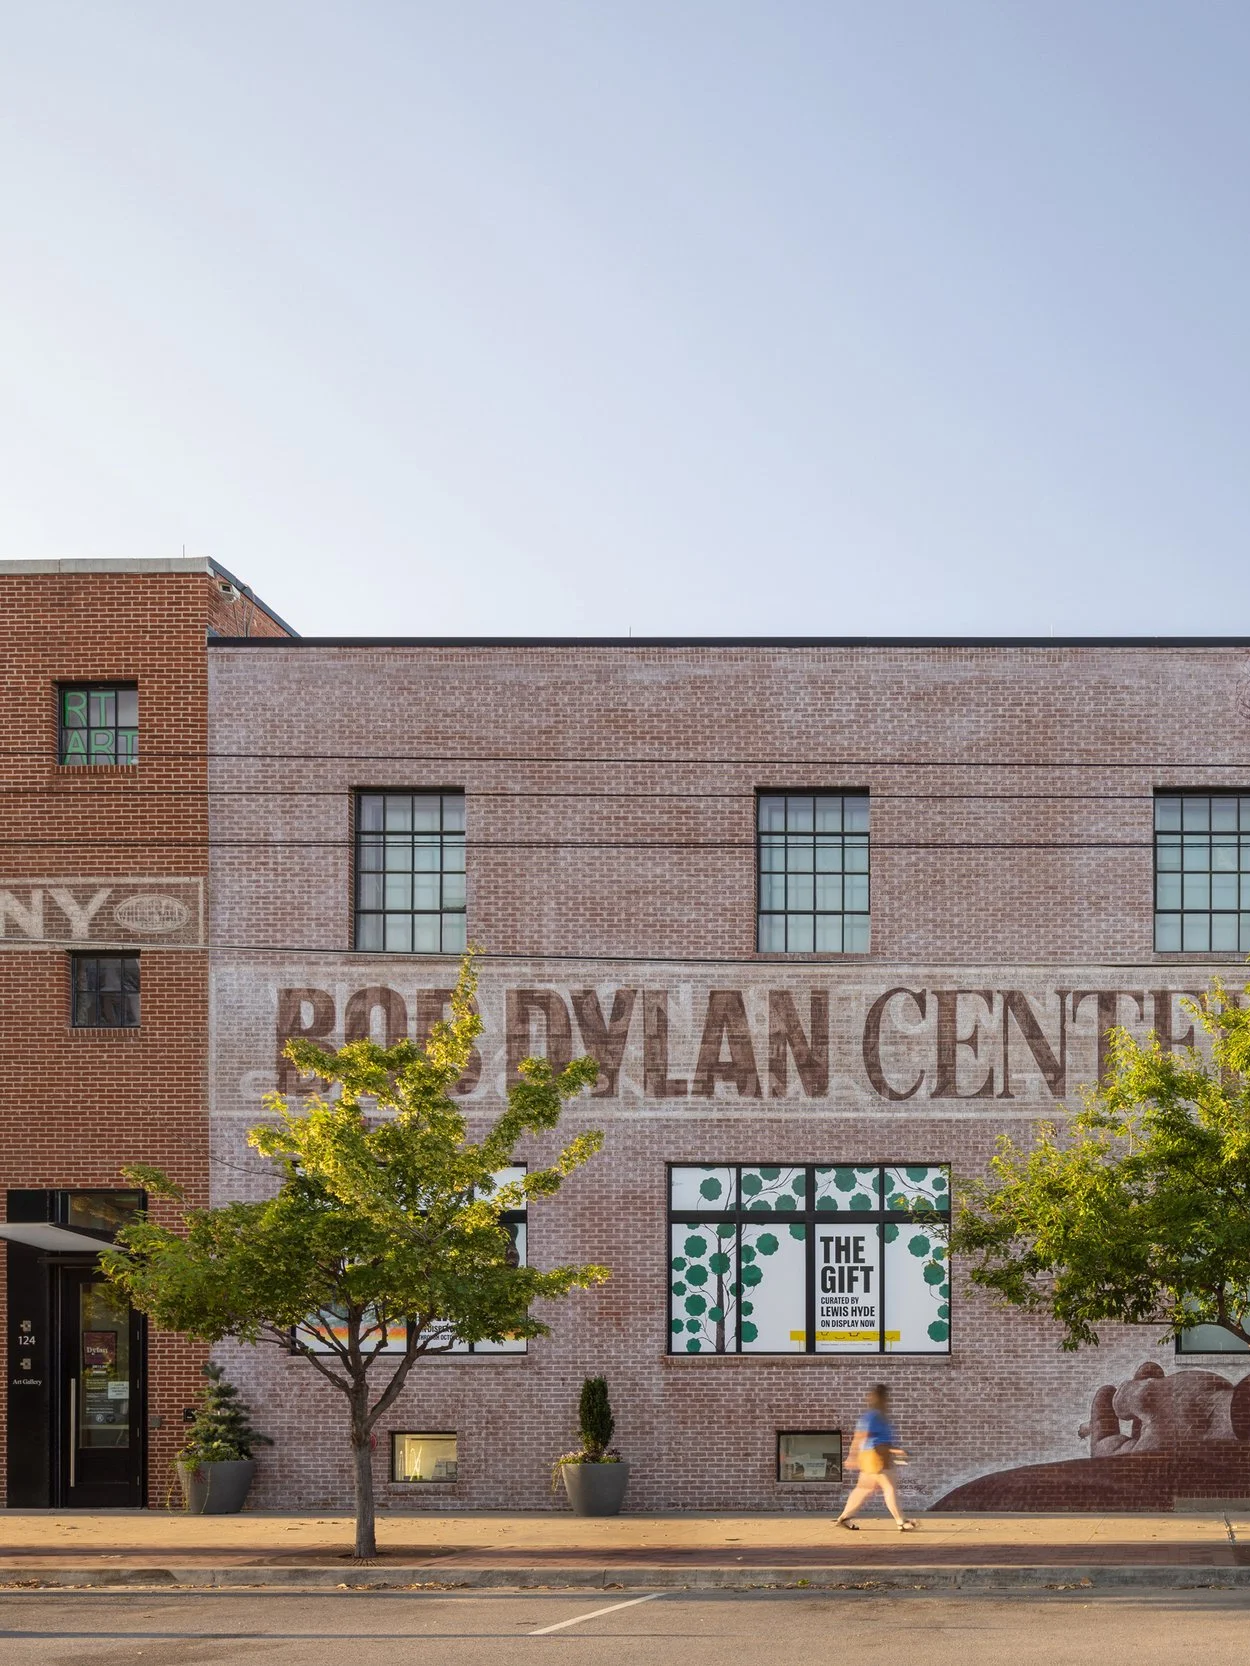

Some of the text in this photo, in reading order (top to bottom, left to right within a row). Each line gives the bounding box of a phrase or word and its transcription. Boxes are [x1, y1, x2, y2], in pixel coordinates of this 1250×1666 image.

[0, 888, 113, 939] NY
[505, 987, 829, 1099] DYLAN
[820, 1236, 865, 1263] THE
[821, 1266, 874, 1293] GIFT
[821, 1297, 859, 1305] CURATED BY
[821, 1306, 875, 1317] LEWIS HYDE
[821, 1320, 875, 1328] ON DISPLAY NOW
[18, 1335, 36, 1345] 124
